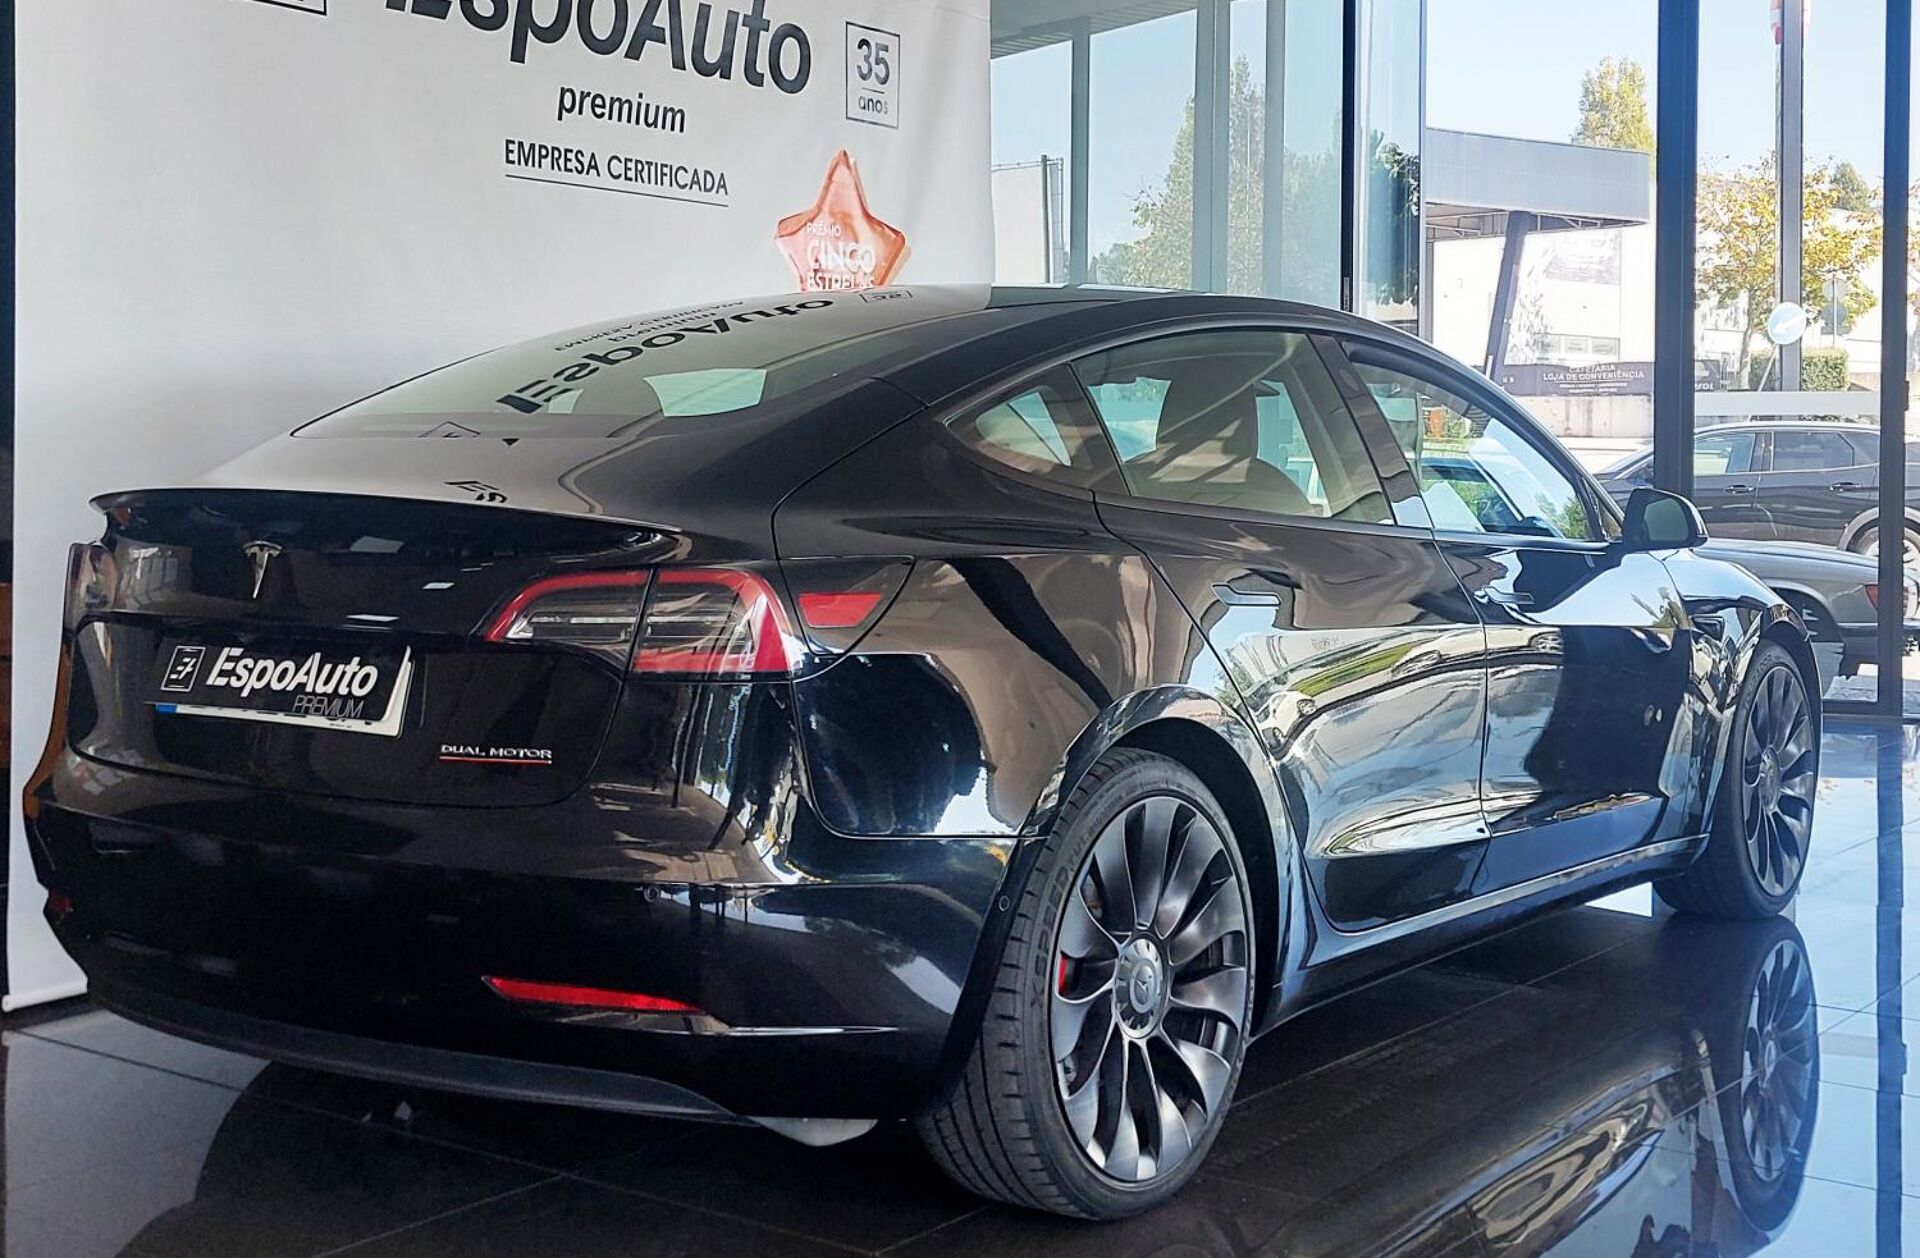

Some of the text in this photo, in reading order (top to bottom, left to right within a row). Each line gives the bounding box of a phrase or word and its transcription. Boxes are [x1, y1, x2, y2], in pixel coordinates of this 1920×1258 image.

[857, 38, 890, 85] 35
[557, 85, 686, 134] premium
[858, 96, 888, 115] anos
[505, 138, 729, 196] EMPRESA CERTIFICADA
[807, 239, 877, 274] CINCO
[1543, 372, 1564, 381] LOJA
[206, 647, 379, 698] EspoAuto
[292, 695, 366, 719] PREMIUM
[440, 744, 553, 759] DUAL MOTOR
